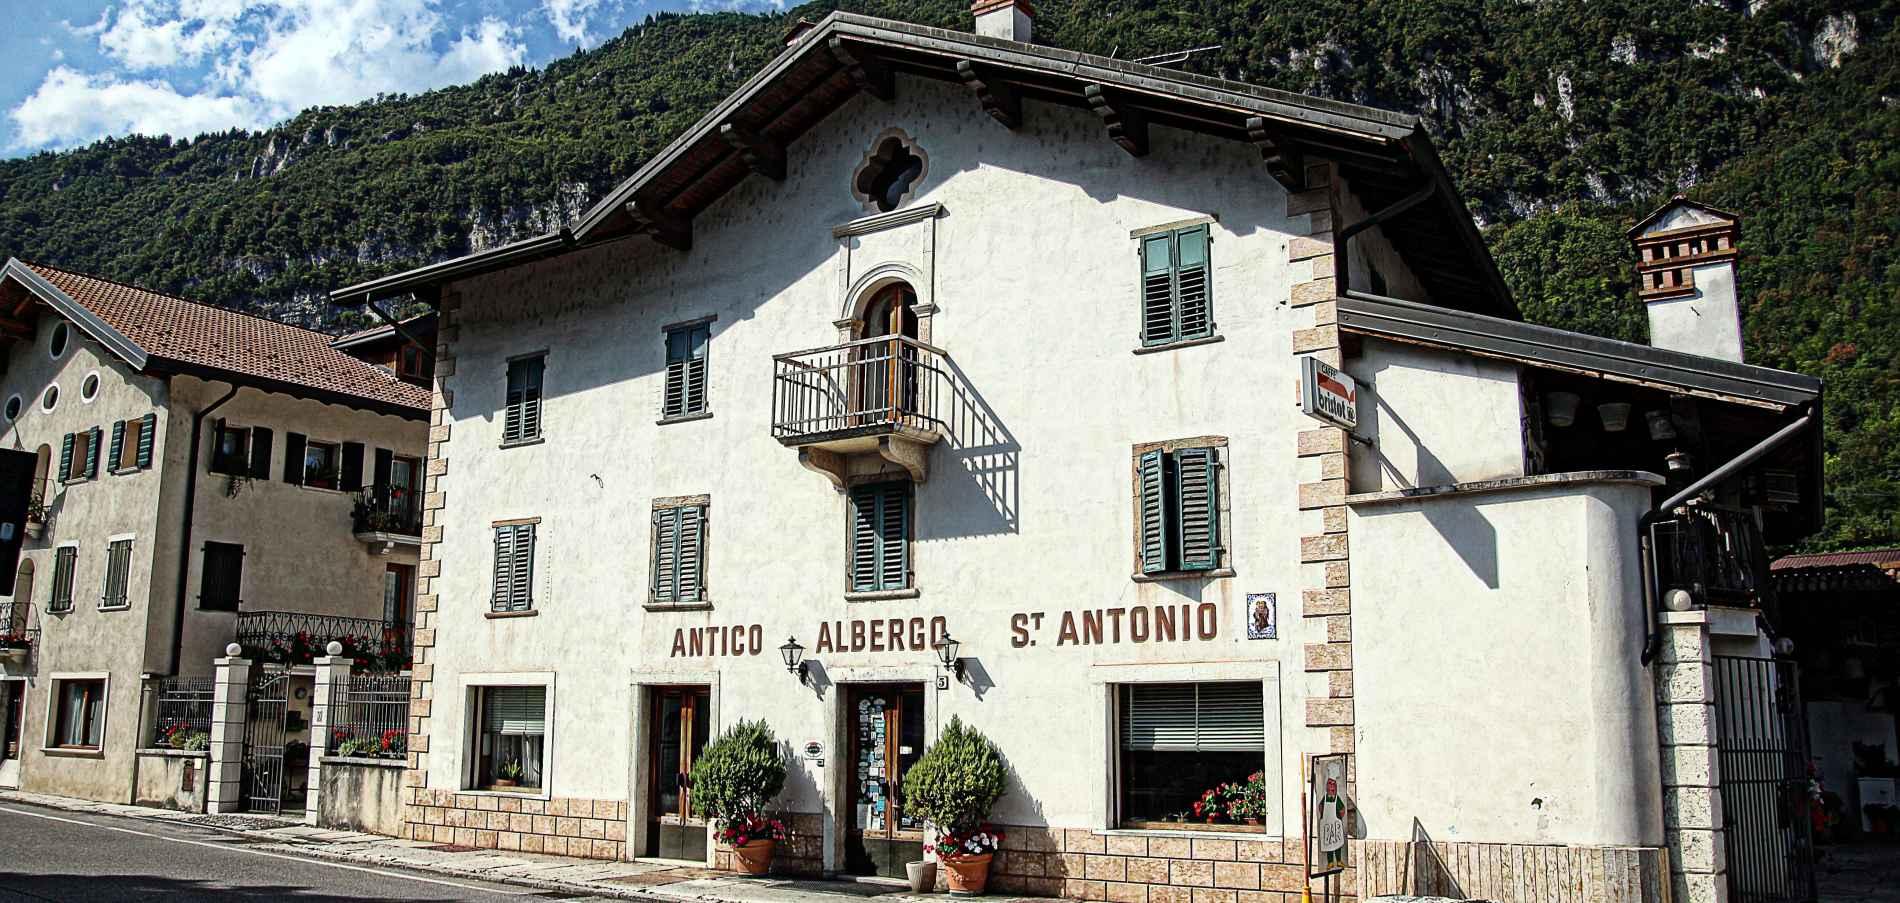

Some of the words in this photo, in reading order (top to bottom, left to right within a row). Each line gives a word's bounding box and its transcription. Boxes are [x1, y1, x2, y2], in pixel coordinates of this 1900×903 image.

[670, 624, 763, 658] ANTICO
[816, 615, 947, 654] ALBERGO
[1057, 602, 1217, 647] ANTONIO
[938, 677, 945, 688] 5
[1323, 822, 1341, 844] BAR
